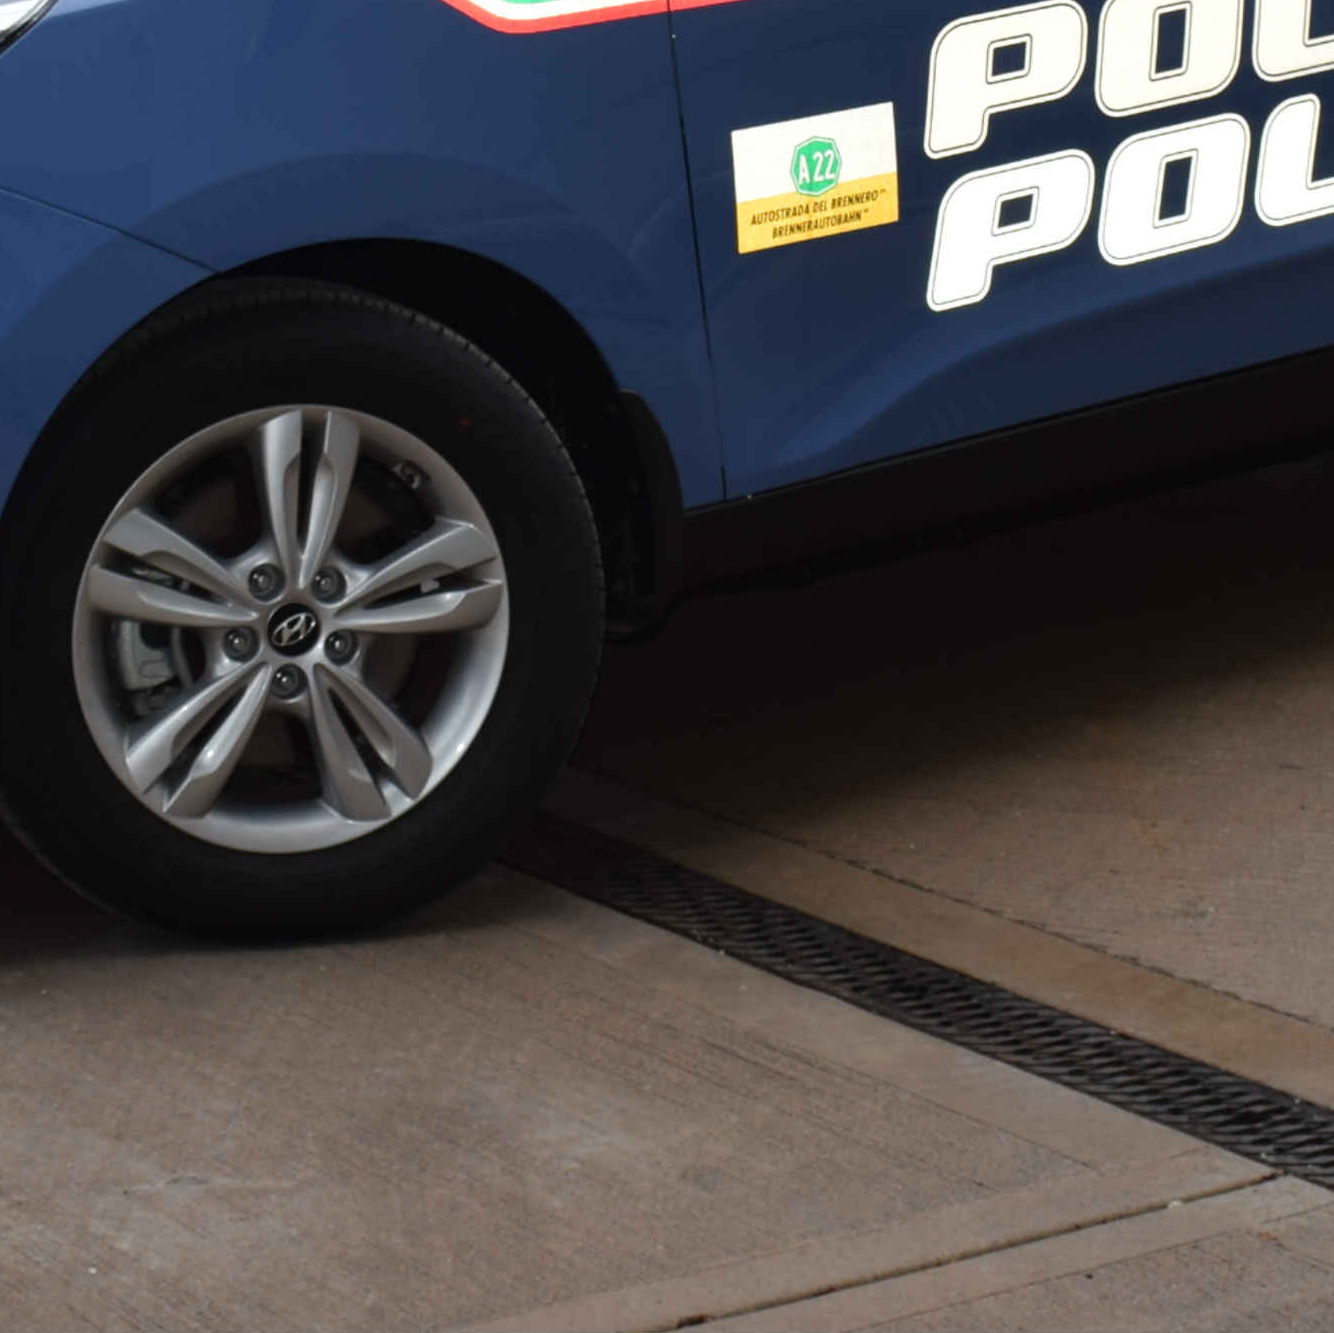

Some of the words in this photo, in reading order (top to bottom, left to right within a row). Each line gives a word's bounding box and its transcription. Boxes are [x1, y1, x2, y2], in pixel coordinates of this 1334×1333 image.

[751, 204, 810, 225] AUTOSTRADA
[812, 200, 827, 213] DEL
[830, 189, 879, 210] BRENNERO
[772, 211, 862, 238] BRENNERAUTOBAHN
